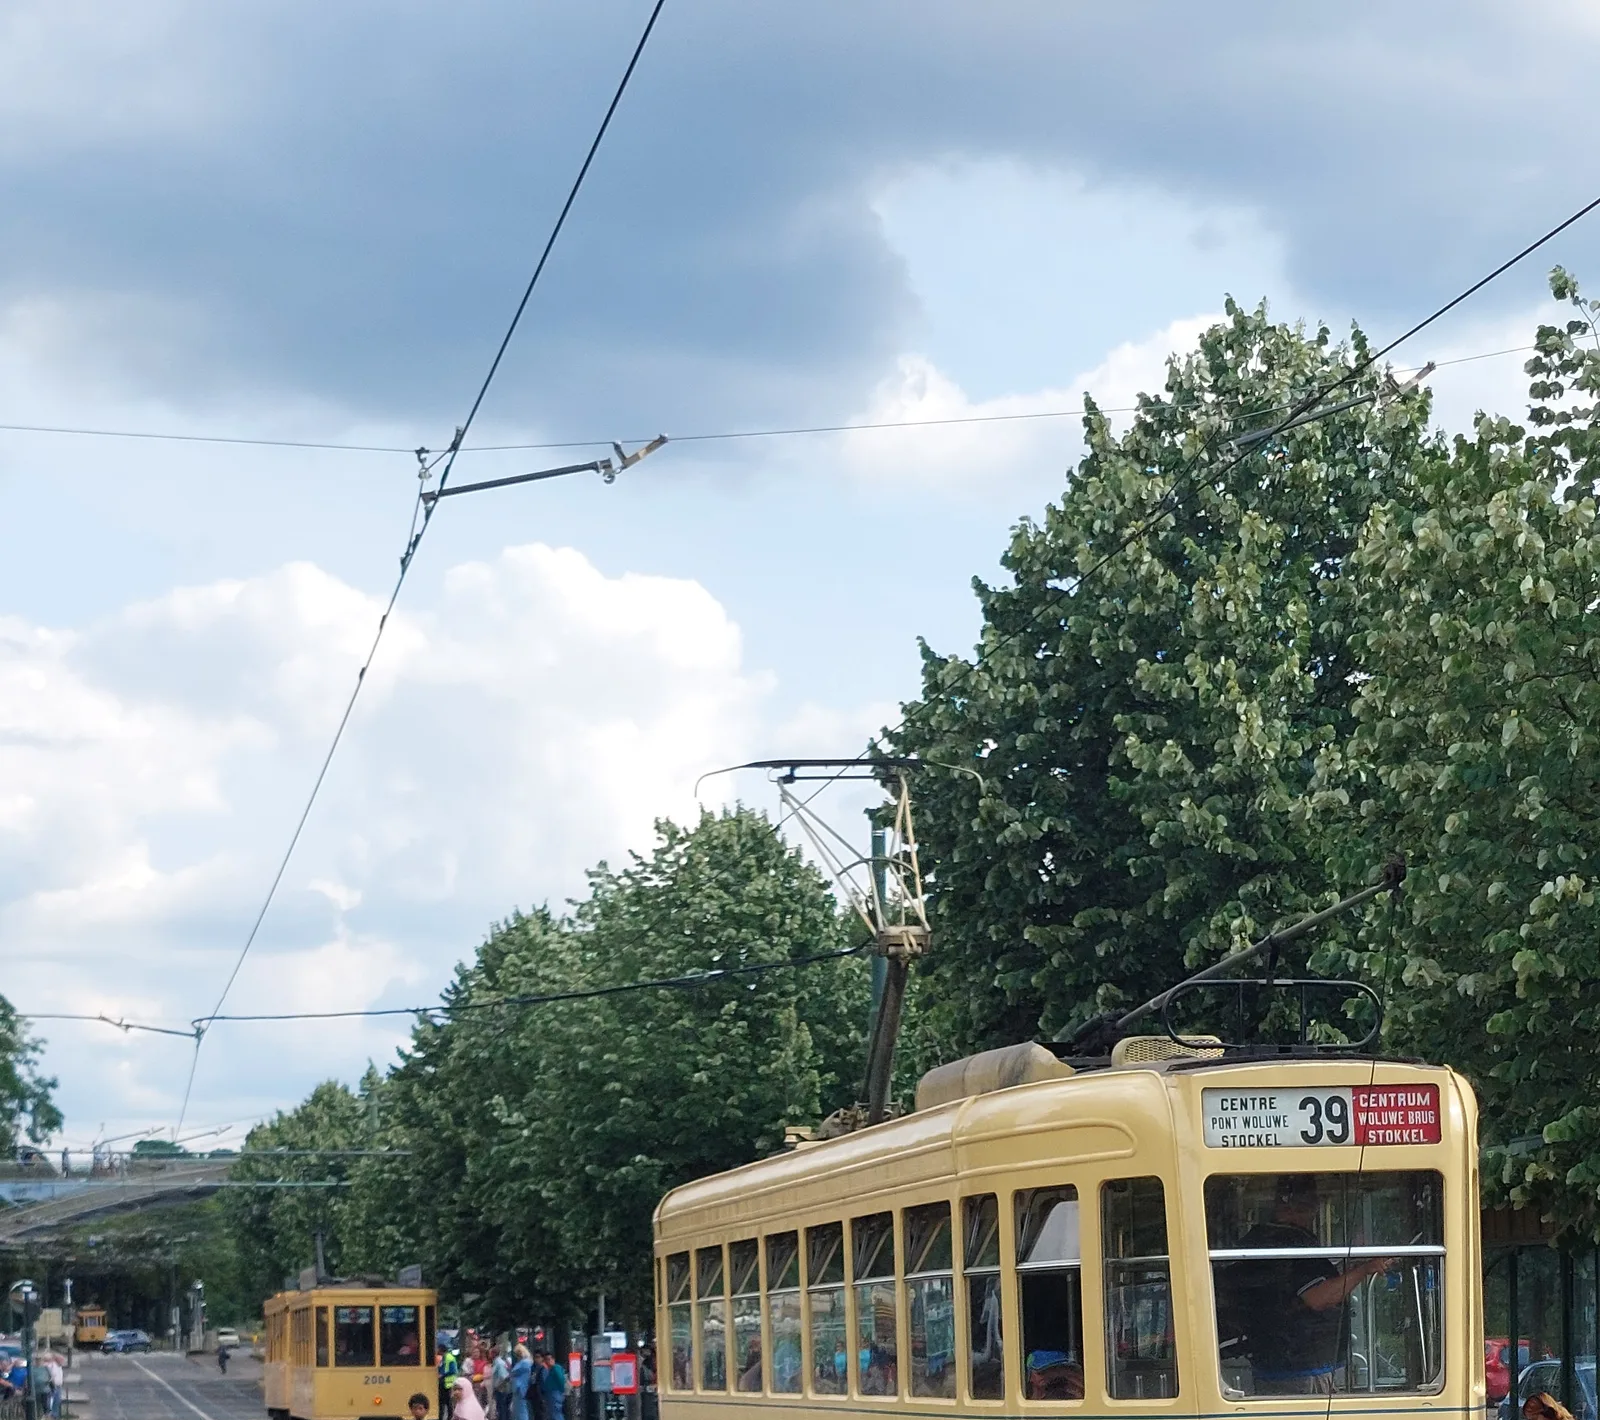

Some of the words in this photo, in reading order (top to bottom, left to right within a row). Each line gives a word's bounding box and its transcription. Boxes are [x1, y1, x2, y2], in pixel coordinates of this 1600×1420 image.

[1220, 1097, 1277, 1111] CENTRE
[1359, 1092, 1430, 1107] CENTRUM
[1211, 1116, 1238, 1130] PONT
[1242, 1115, 1289, 1129] WOLUWE
[1299, 1096, 1349, 1144] 39
[1358, 1111, 1405, 1126] WOLUWE
[1408, 1110, 1435, 1125] BRUG
[1221, 1133, 1282, 1147] STOCKEL
[1368, 1129, 1428, 1143] STOKKEL
